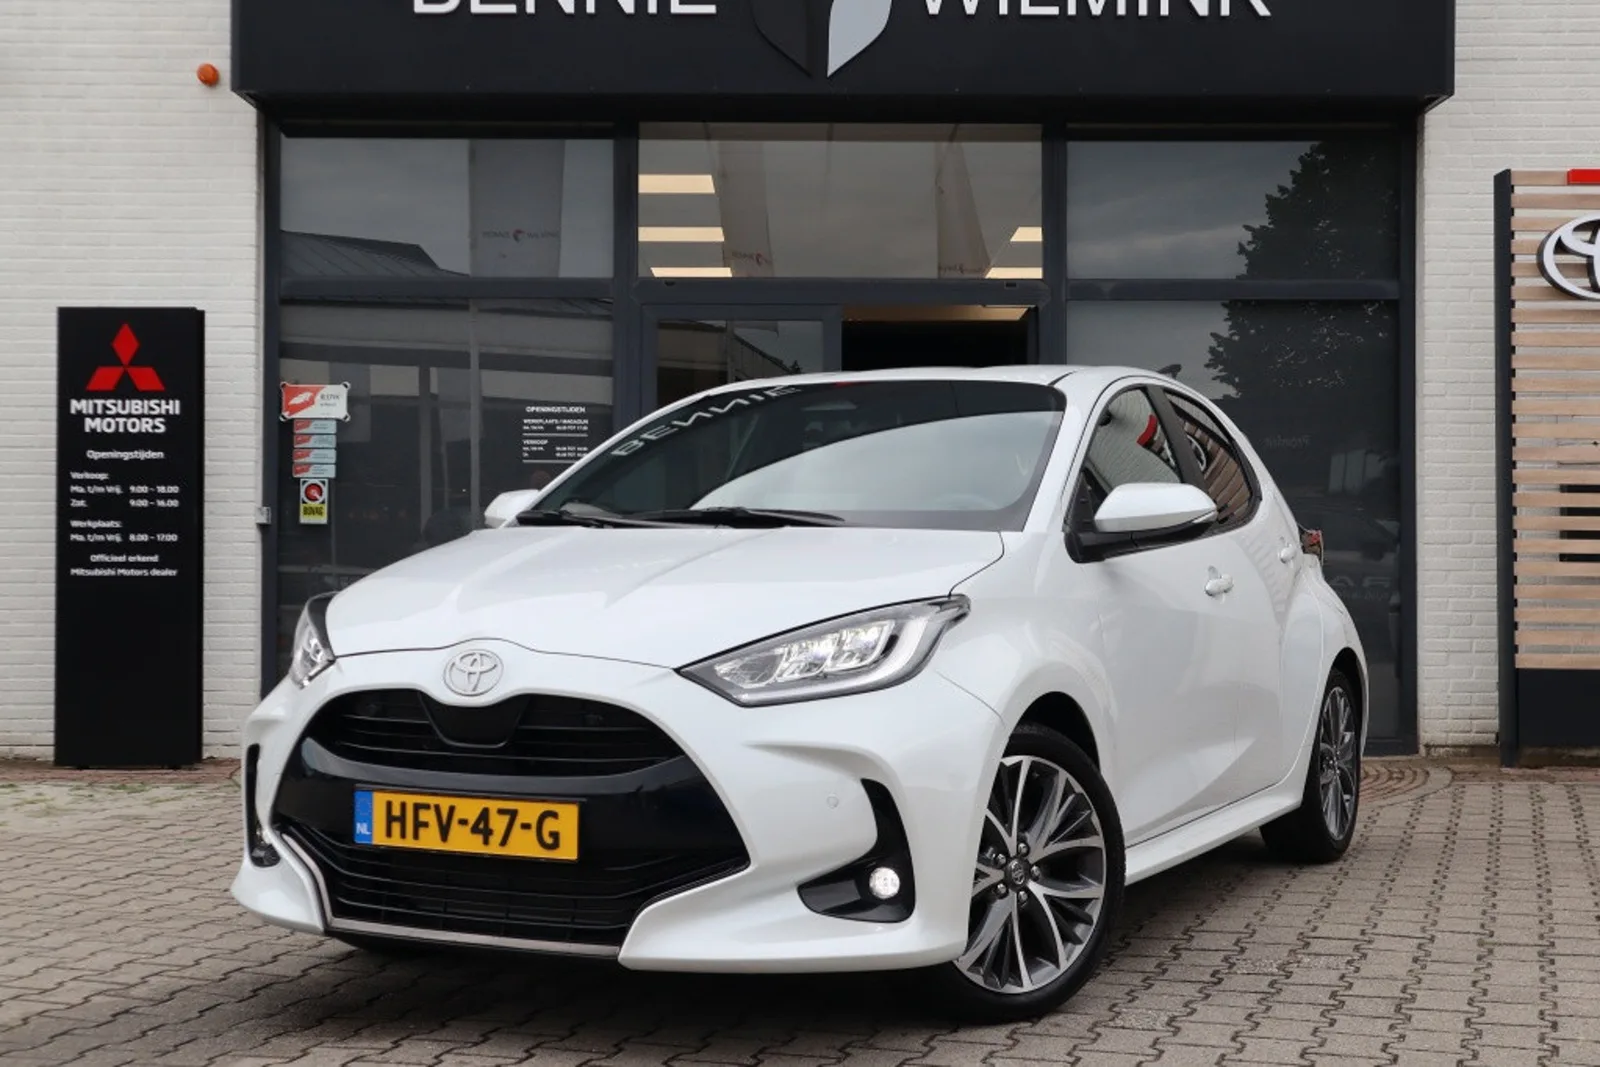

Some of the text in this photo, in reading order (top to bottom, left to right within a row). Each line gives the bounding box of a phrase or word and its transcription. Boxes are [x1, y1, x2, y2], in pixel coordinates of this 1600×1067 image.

[70, 399, 180, 415] MITSUBISHI
[84, 417, 166, 433] MOTORS
[86, 449, 164, 460] Openingstijden
[70, 472, 109, 480] Verkoop:
[70, 520, 123, 529] Werkplaats:
[90, 554, 159, 562] Officieel erkend
[70, 568, 178, 576] Mitsubishi Motors dealer
[356, 800, 561, 851] NL HFV-47-G
